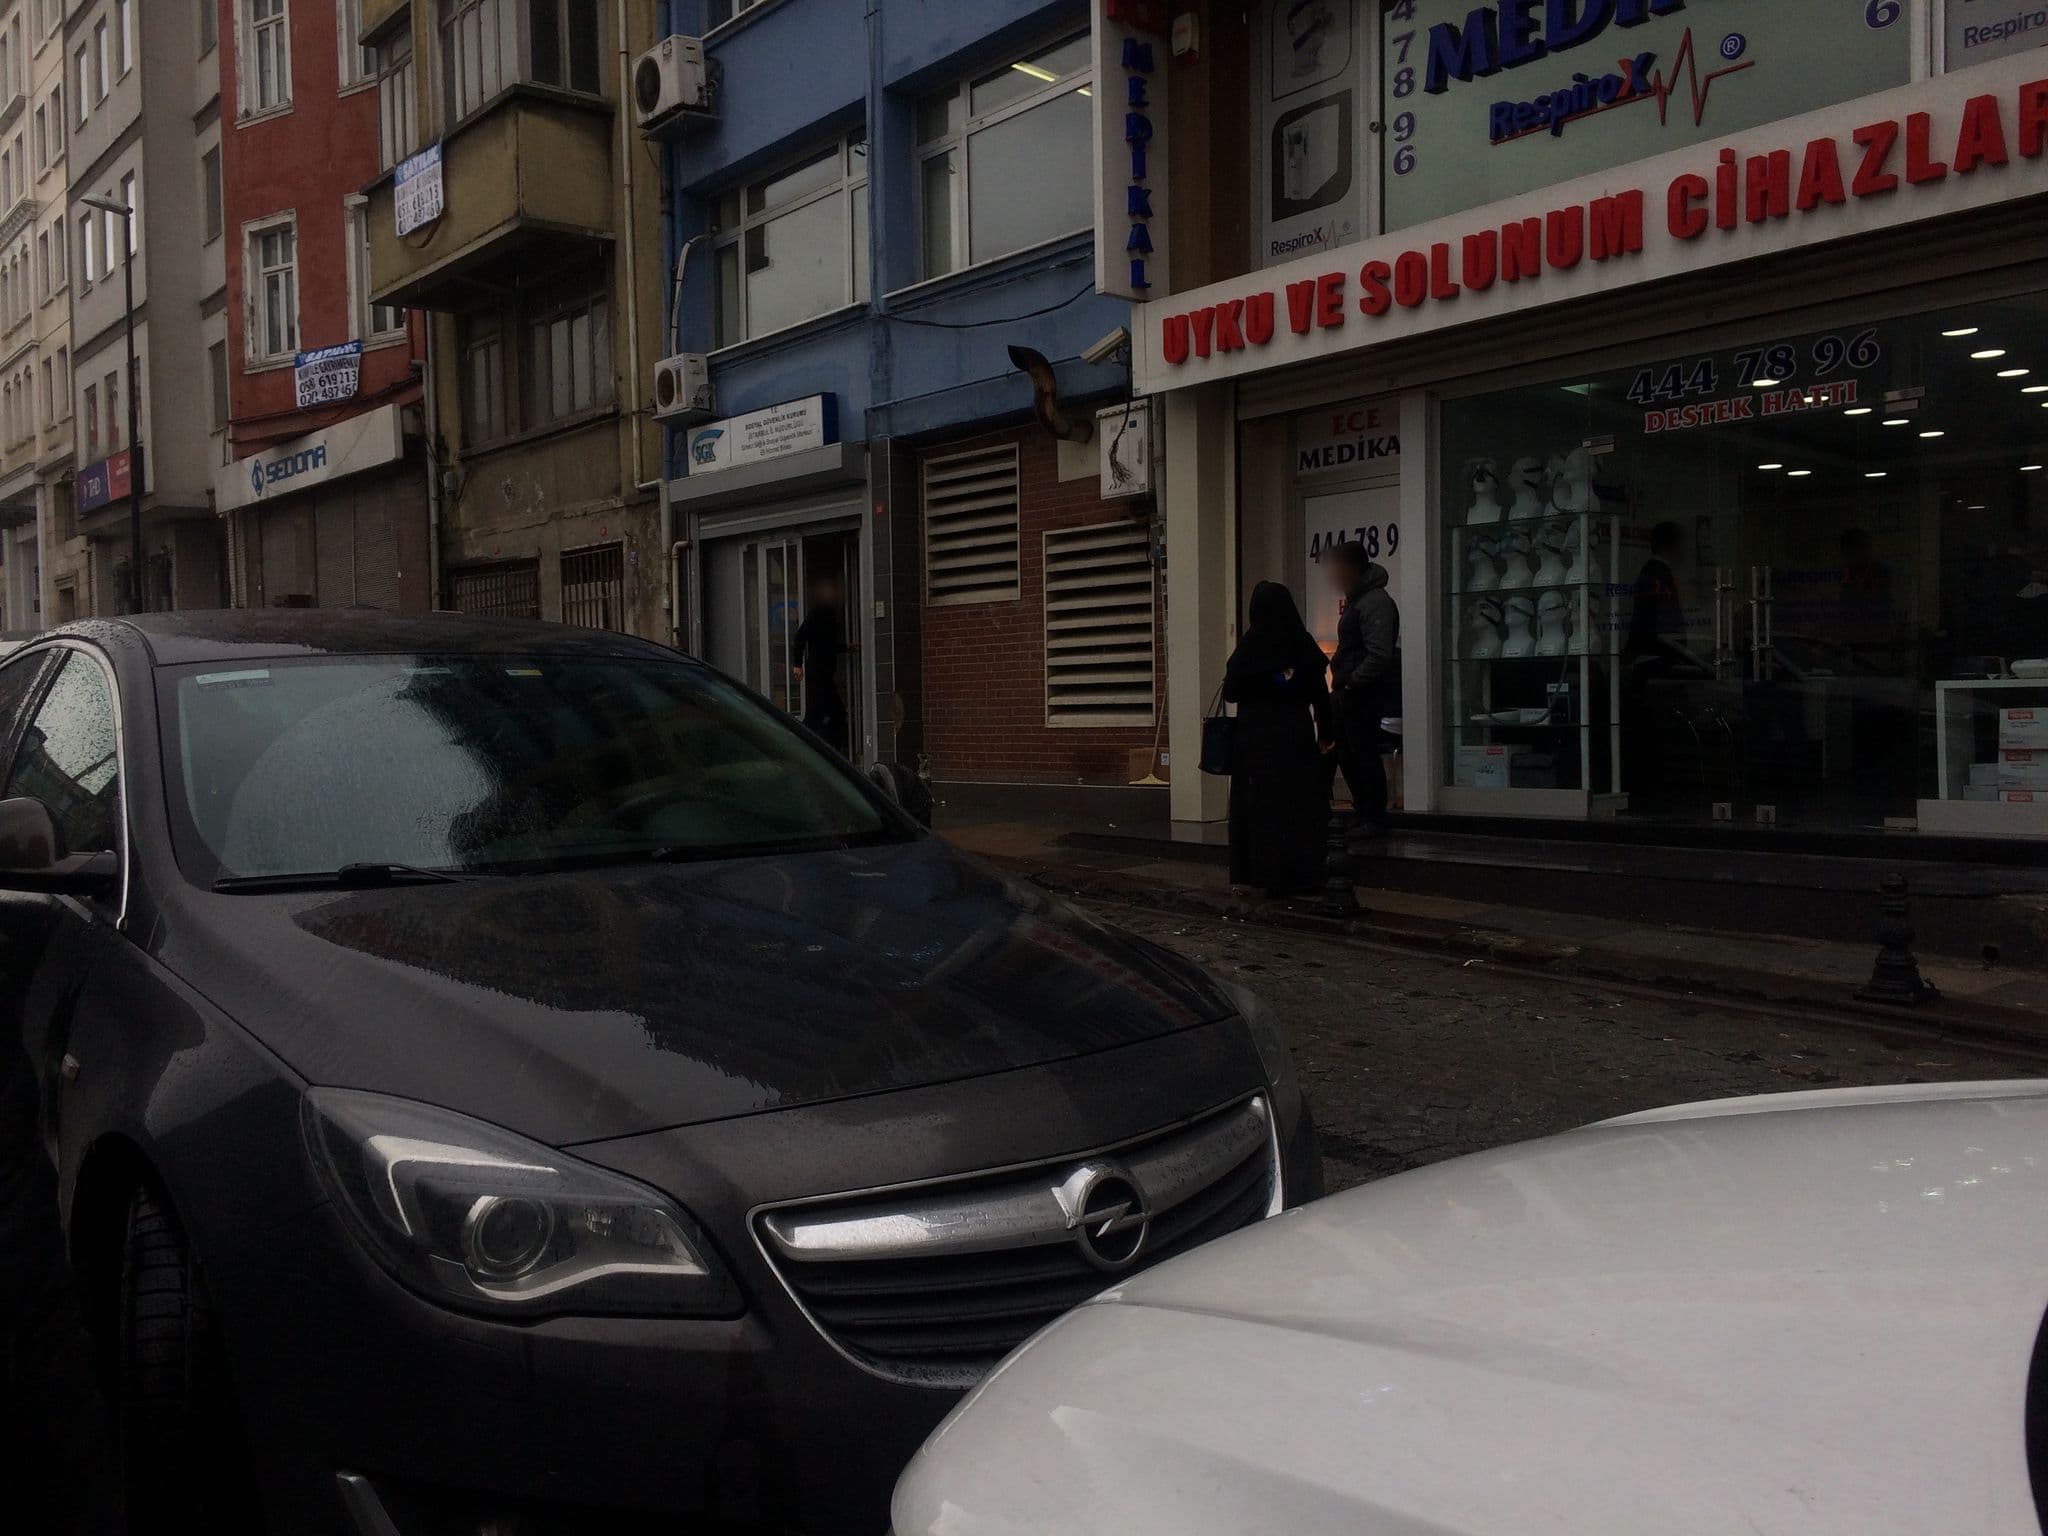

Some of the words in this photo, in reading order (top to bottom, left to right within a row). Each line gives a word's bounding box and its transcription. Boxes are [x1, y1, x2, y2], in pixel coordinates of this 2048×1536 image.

[1271, 227, 1323, 256] RespiroX
[1163, 291, 1275, 365] UYKU
[1286, 271, 1346, 335] VE
[1359, 189, 1644, 317] SOLUNUM
[1626, 357, 1719, 404] 444
[1733, 343, 1797, 387] 78
[1811, 327, 1880, 376] 96
[1333, 408, 1380, 434] ECE
[1643, 395, 1753, 434] DESTEK
[1760, 379, 1858, 416] HATTI
[695, 442, 716, 461] SGK
[1387, 523, 1399, 558] 9
